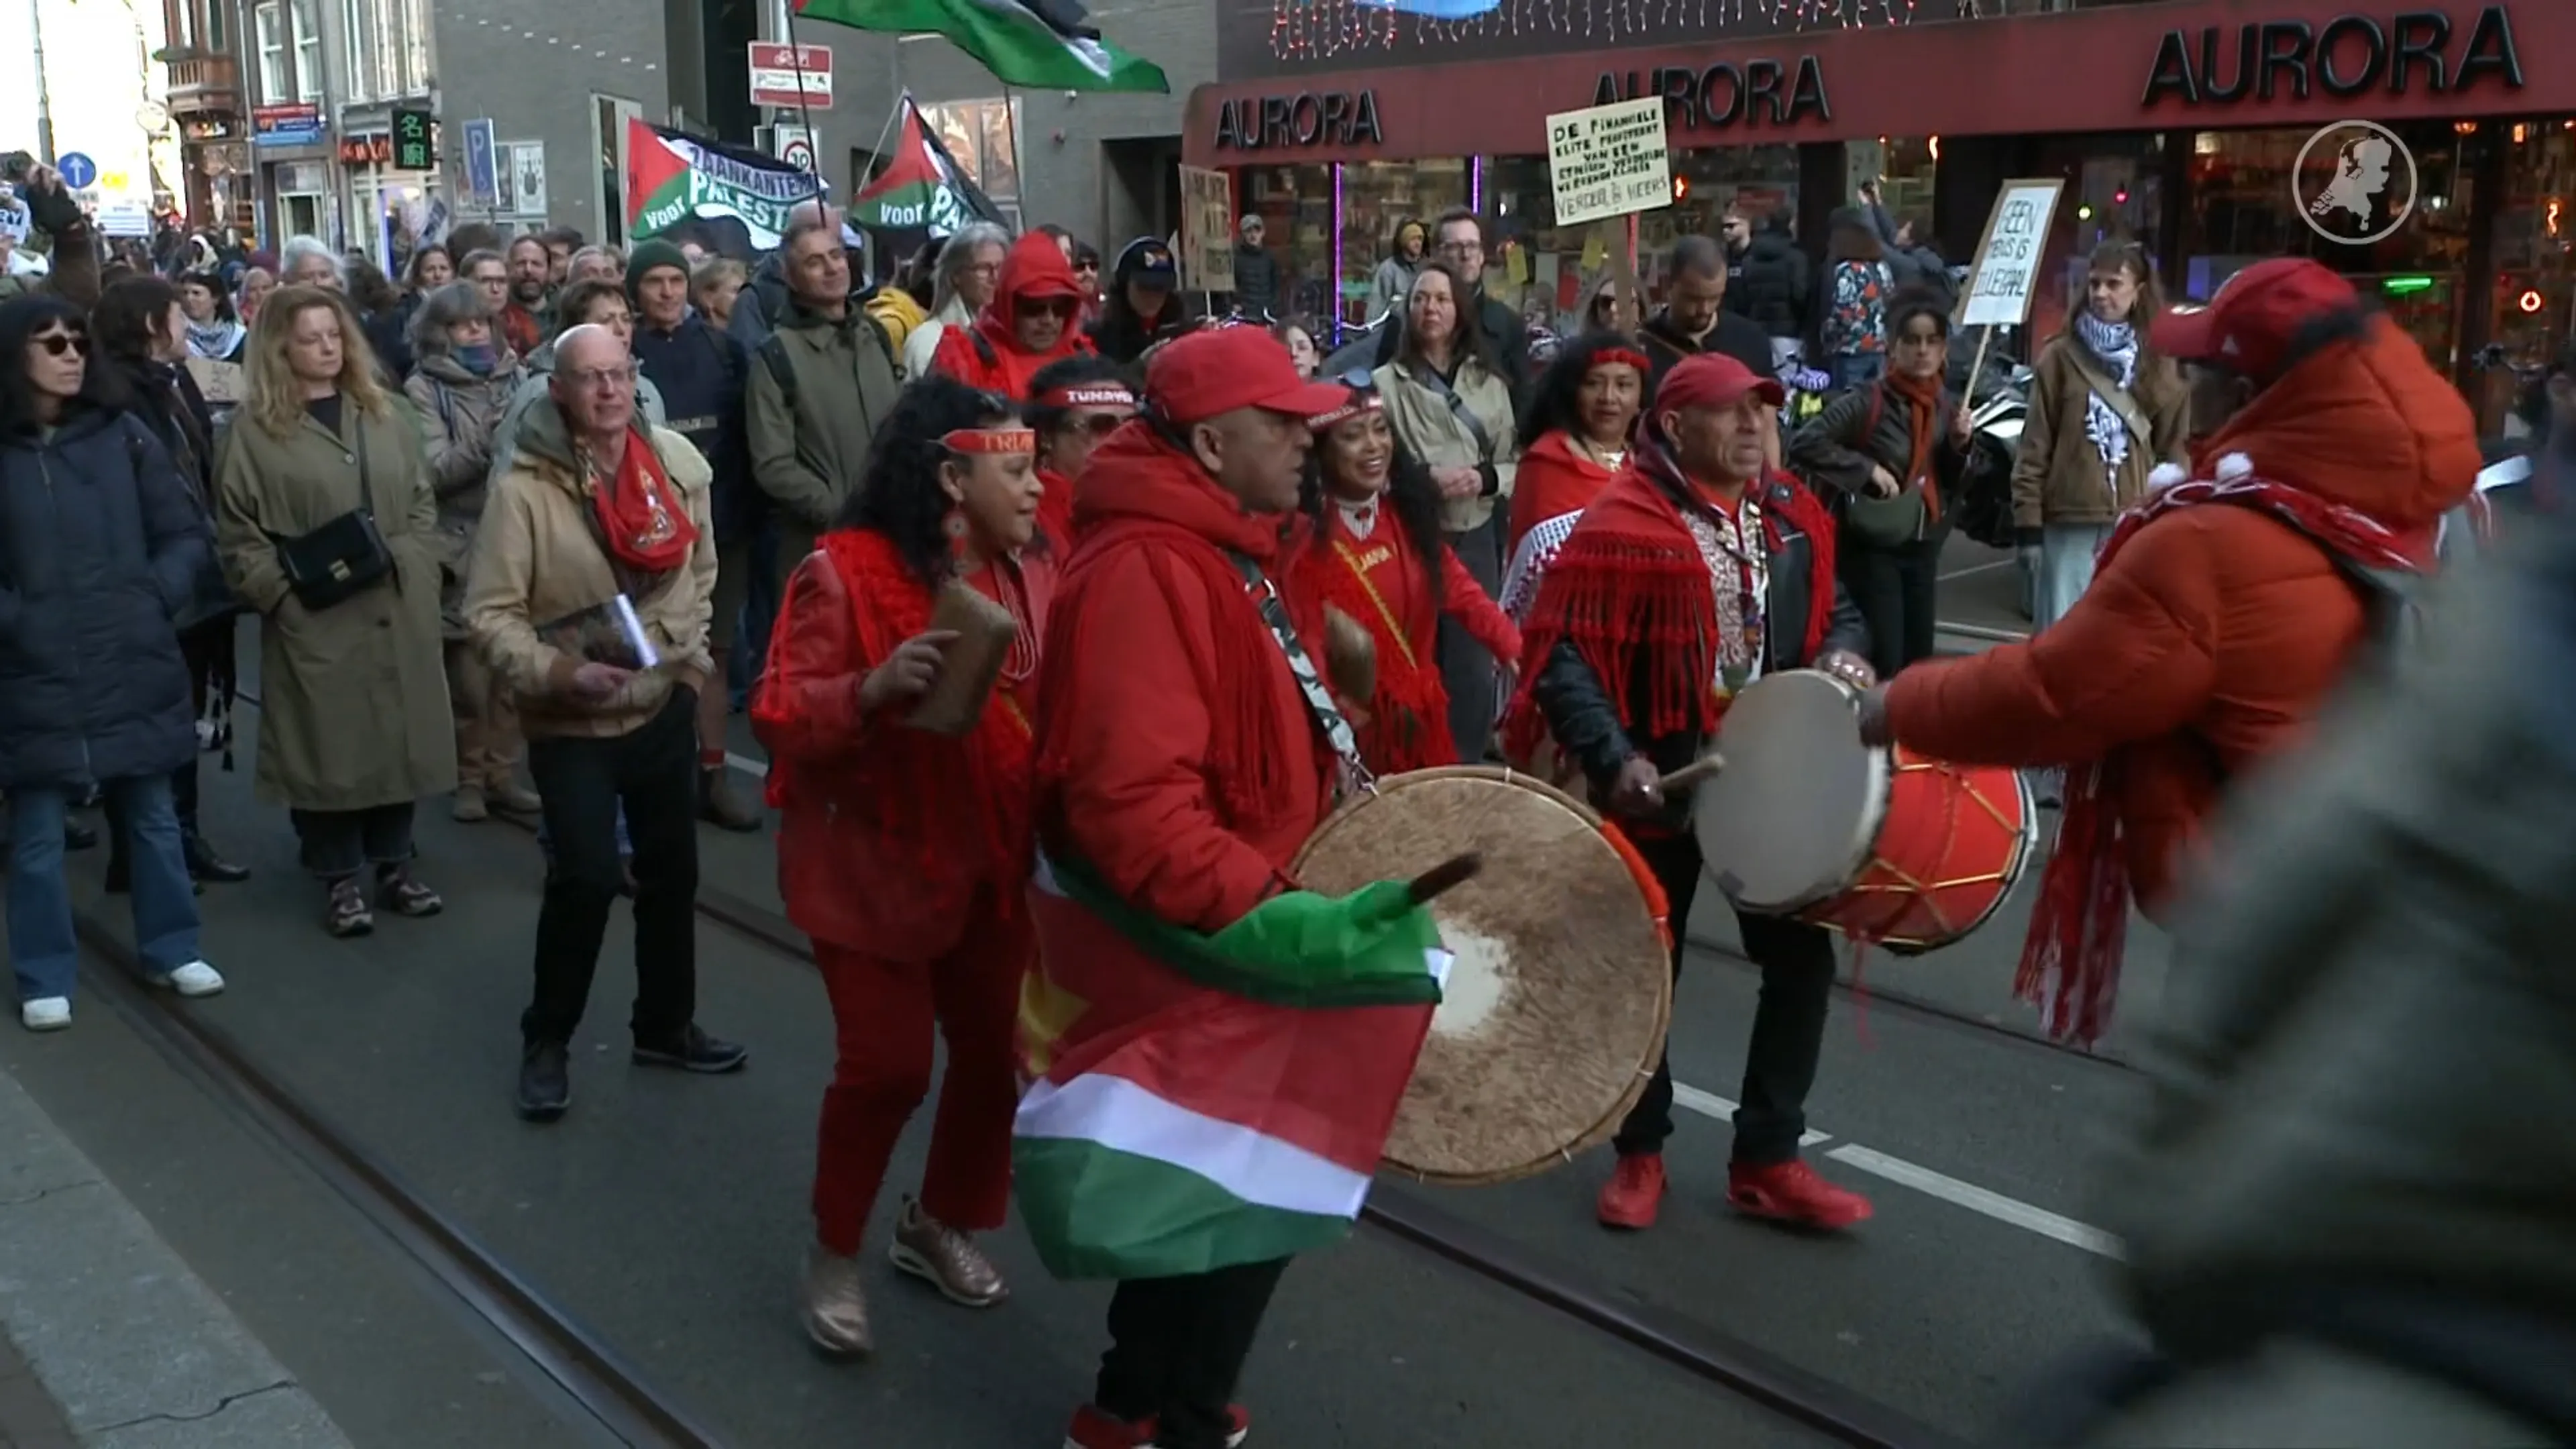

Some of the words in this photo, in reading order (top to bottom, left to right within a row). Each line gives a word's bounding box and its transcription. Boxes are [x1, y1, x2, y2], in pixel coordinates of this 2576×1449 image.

[2141, 4, 2523, 106] AURORA
[1214, 89, 1383, 148] AURORA
[1554, 123, 1578, 143] DE
[471, 129, 485, 167] P
[1584, 150, 1608, 162] VAN
